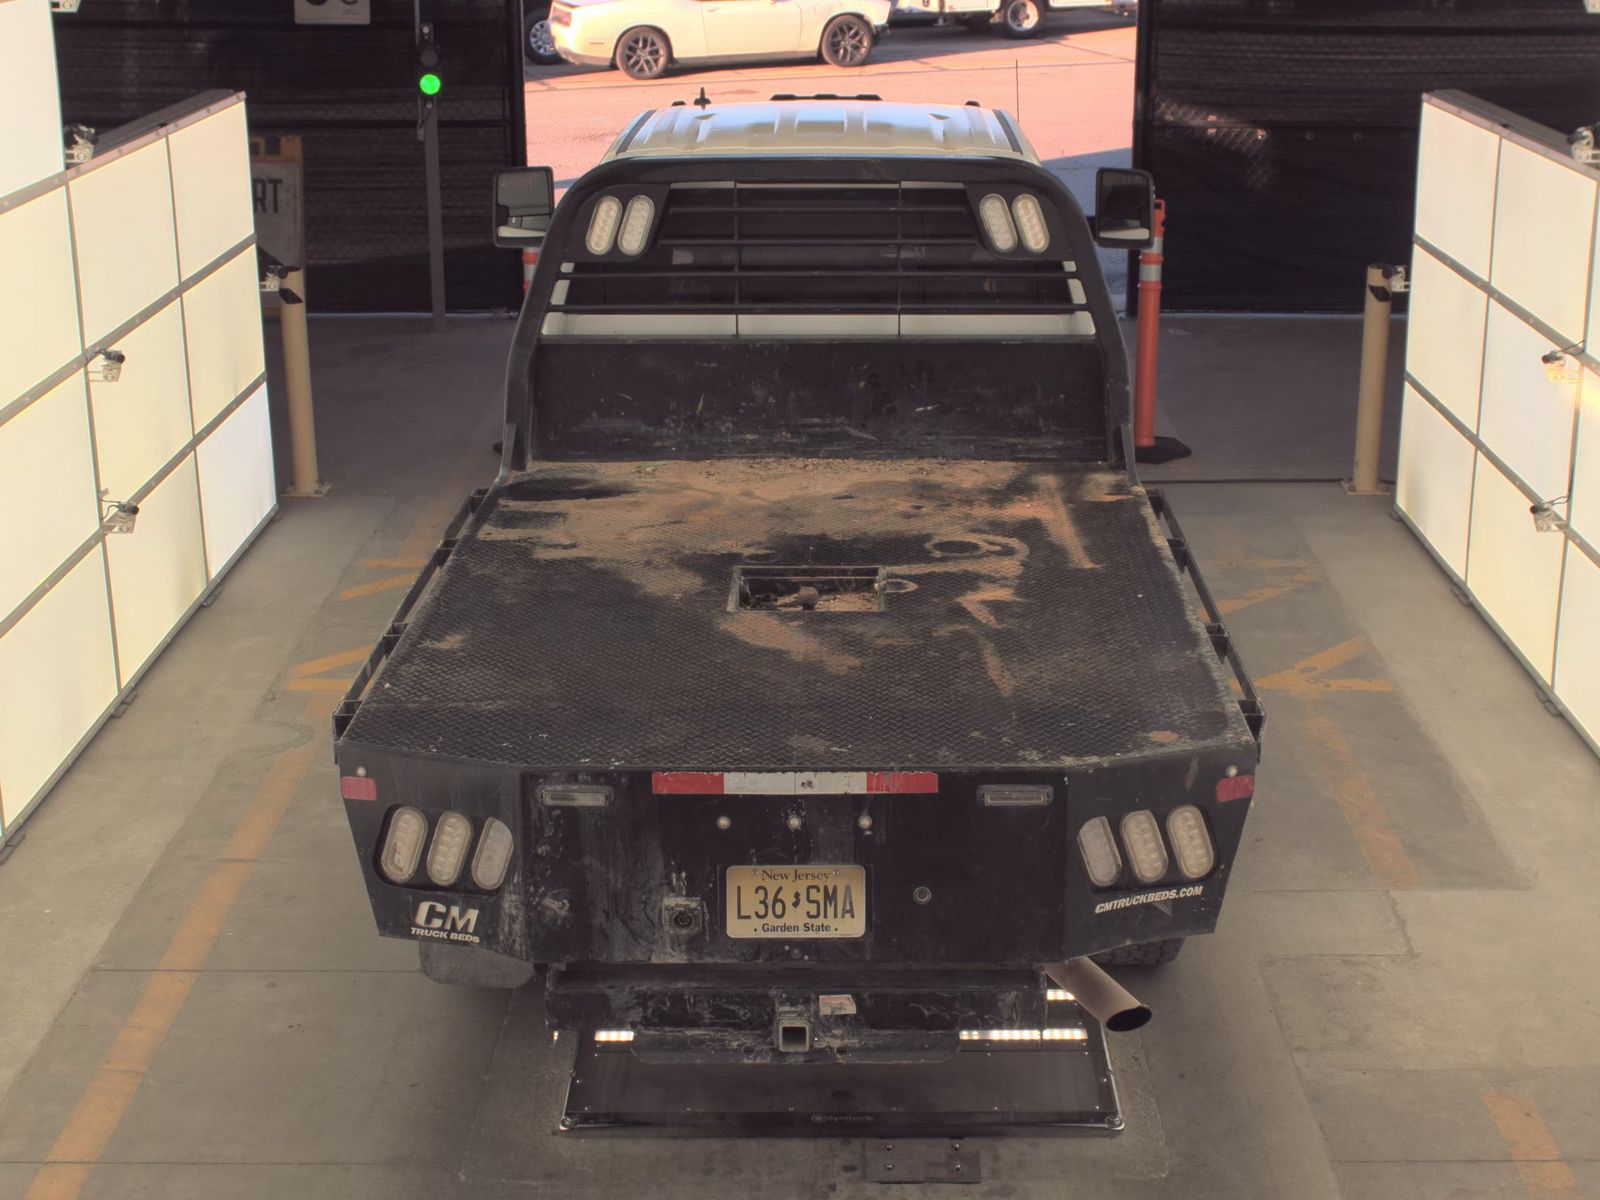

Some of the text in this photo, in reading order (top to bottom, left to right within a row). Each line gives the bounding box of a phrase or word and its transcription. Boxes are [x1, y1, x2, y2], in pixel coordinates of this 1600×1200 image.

[761, 869, 831, 883] New Jersey
[736, 884, 855, 920] L36 SMA
[1094, 885, 1204, 914] CMTRUCKBEDS.COM
[414, 900, 480, 933] CM
[761, 922, 831, 932] Garden State
[410, 926, 480, 943] TRUCK BEDS
